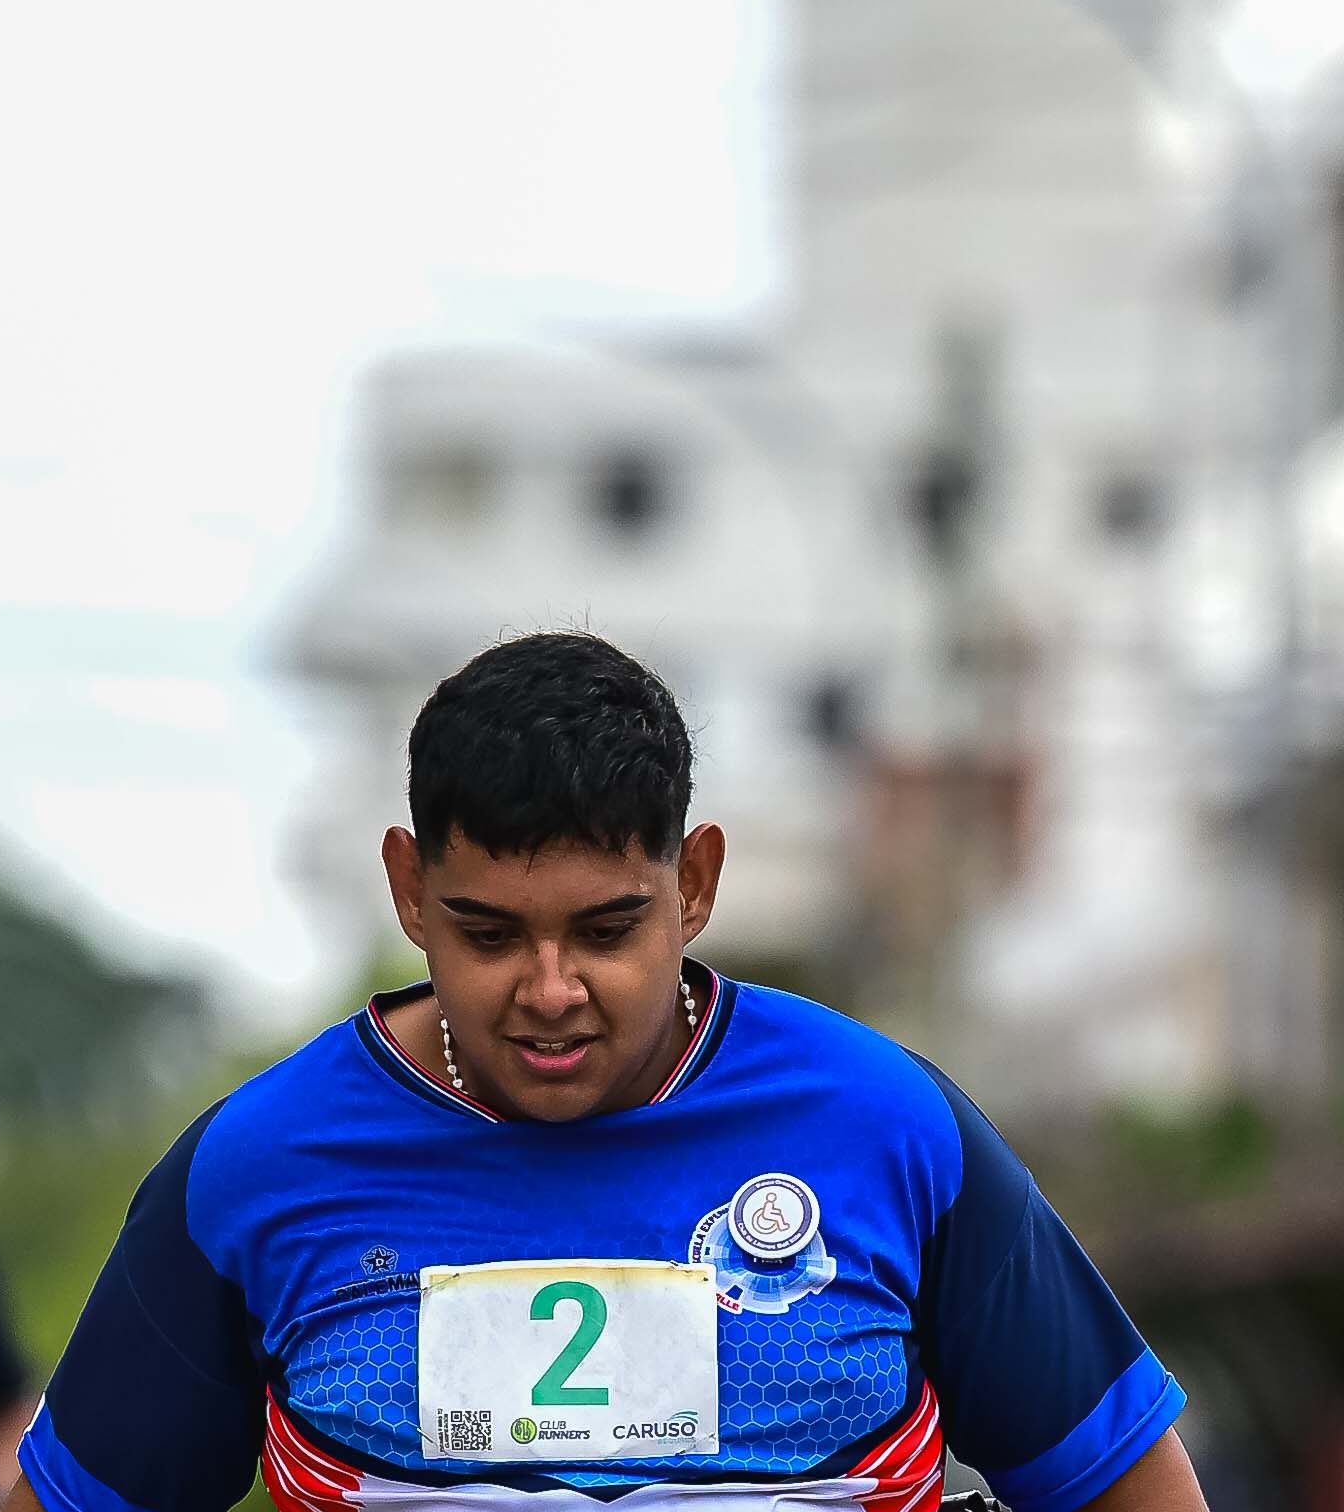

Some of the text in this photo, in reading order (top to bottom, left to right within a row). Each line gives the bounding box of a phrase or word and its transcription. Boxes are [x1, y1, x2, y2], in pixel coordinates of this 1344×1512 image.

[529, 1281, 609, 1406] 2
[539, 1420, 567, 1430] CLUB
[613, 1422, 696, 1440] CARUSO
